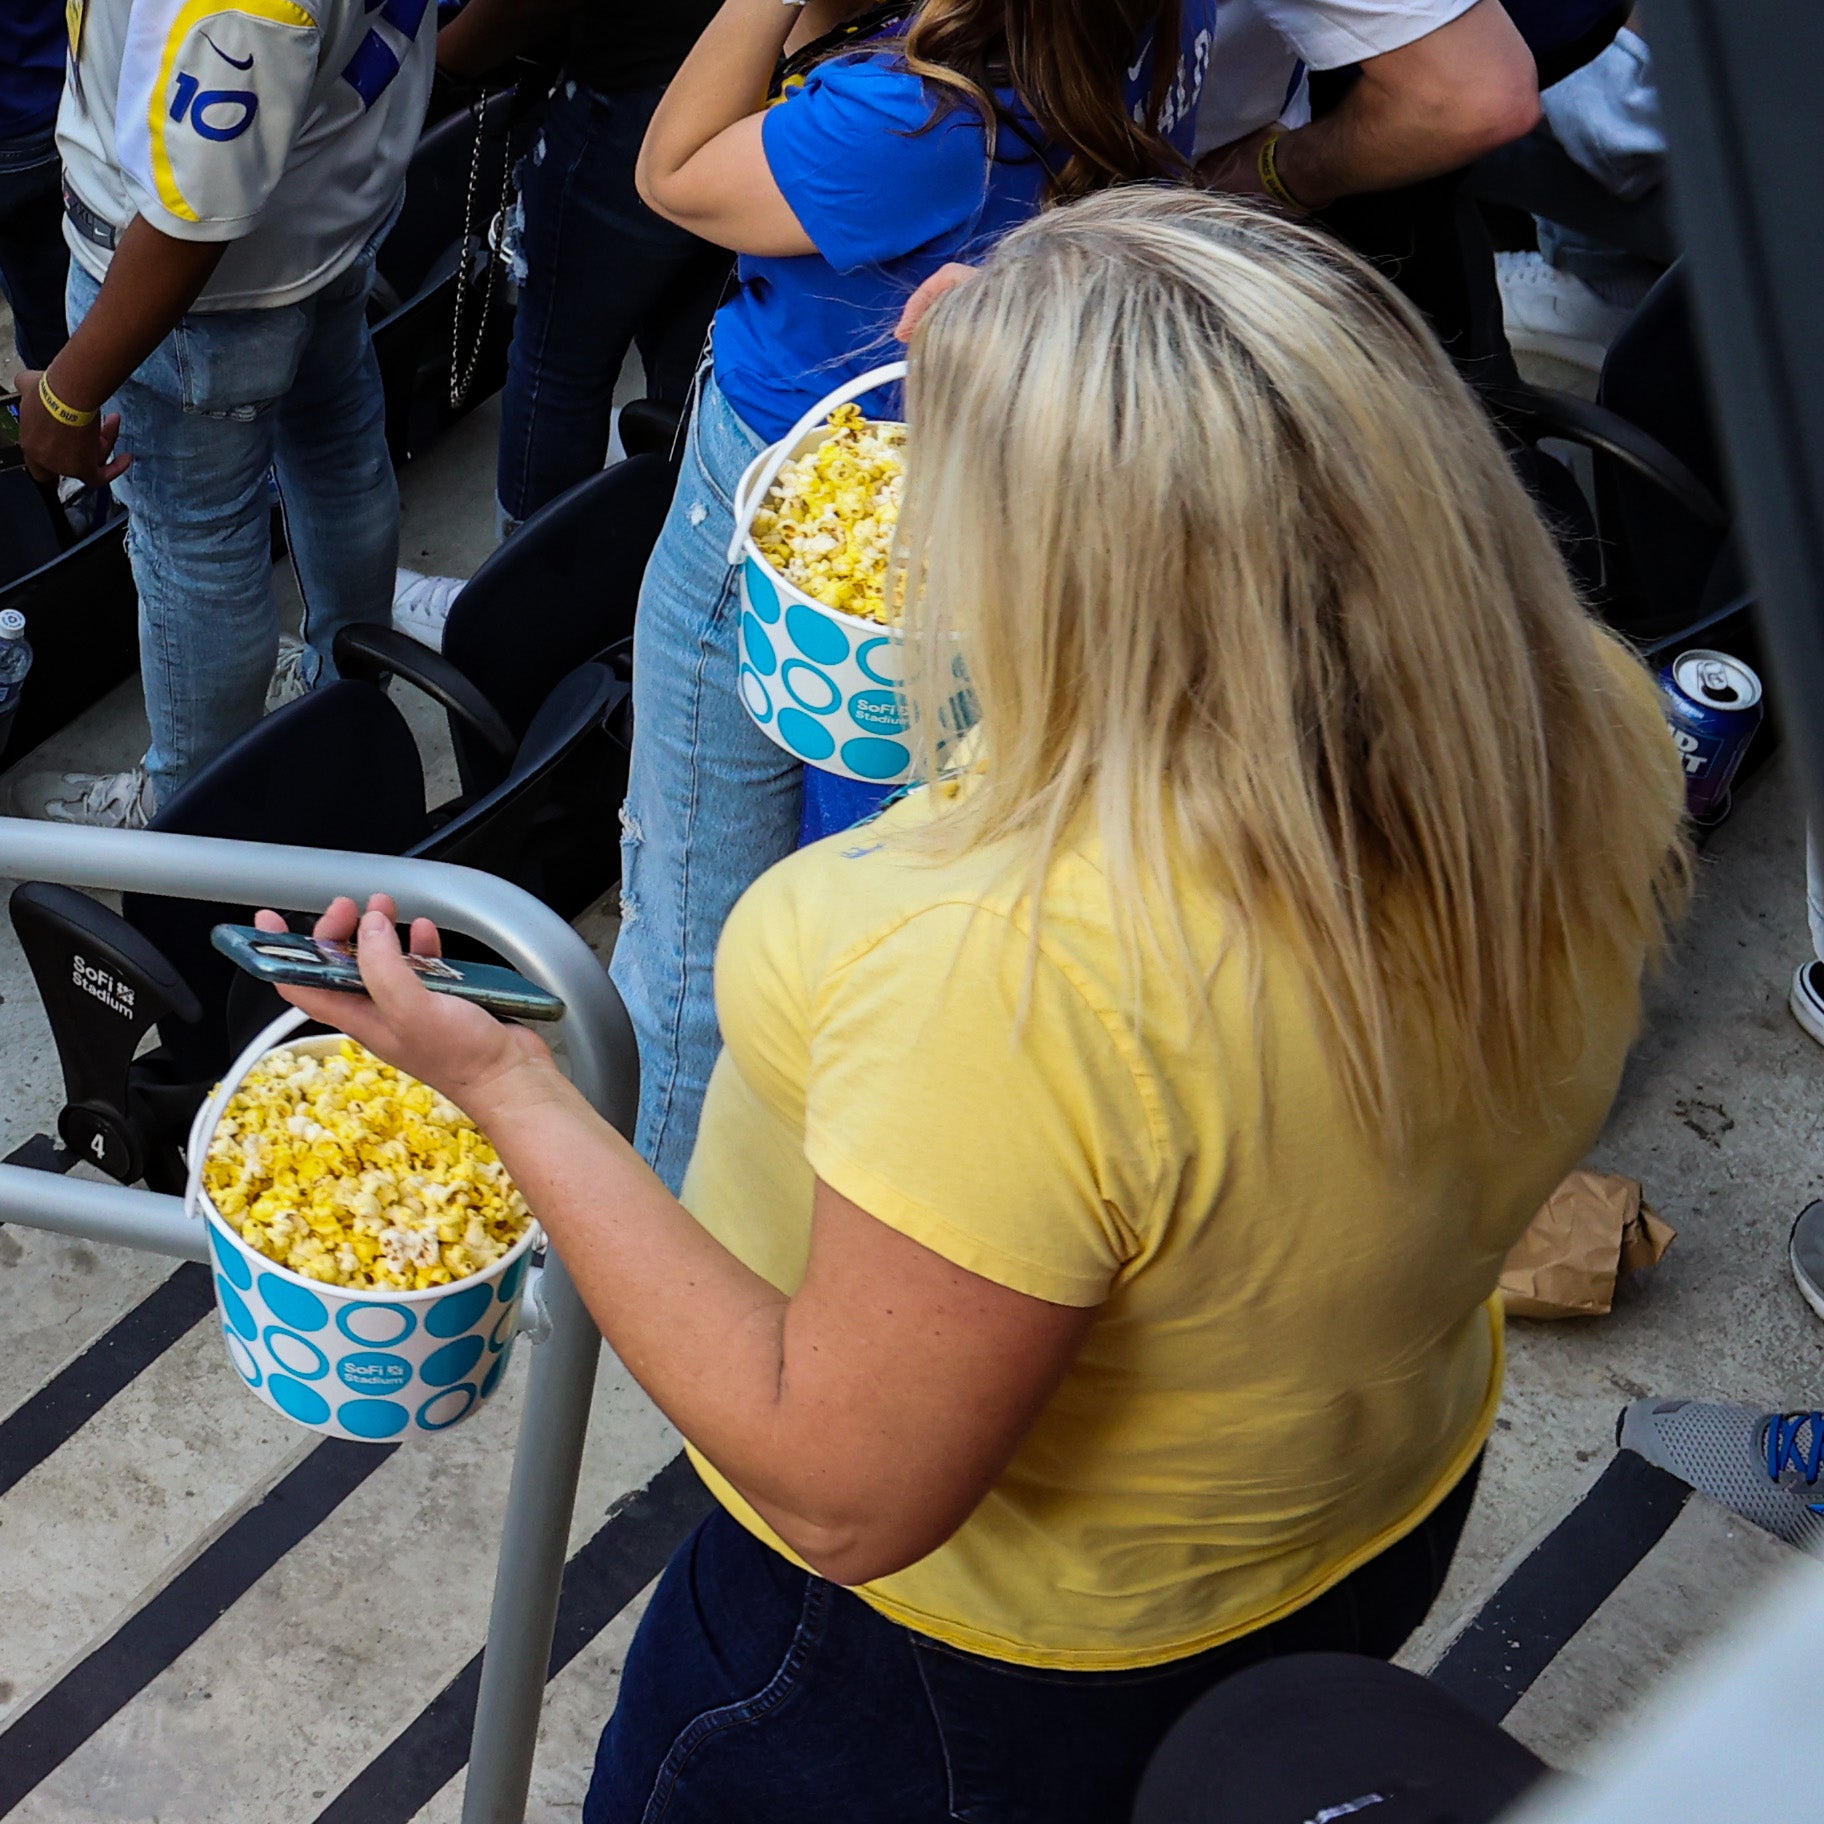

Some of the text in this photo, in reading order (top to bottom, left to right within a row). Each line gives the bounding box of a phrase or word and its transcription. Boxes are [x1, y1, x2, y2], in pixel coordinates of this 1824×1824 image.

[169, 71, 259, 142] 10
[60, 407, 79, 423] BUS
[857, 699, 896, 715] SoFi
[73, 954, 113, 993] SoFi
[72, 971, 133, 1020] Stadium
[90, 1132, 106, 1160] 4
[343, 1362, 384, 1376] SoFi
[343, 1373, 404, 1385] Stadium
